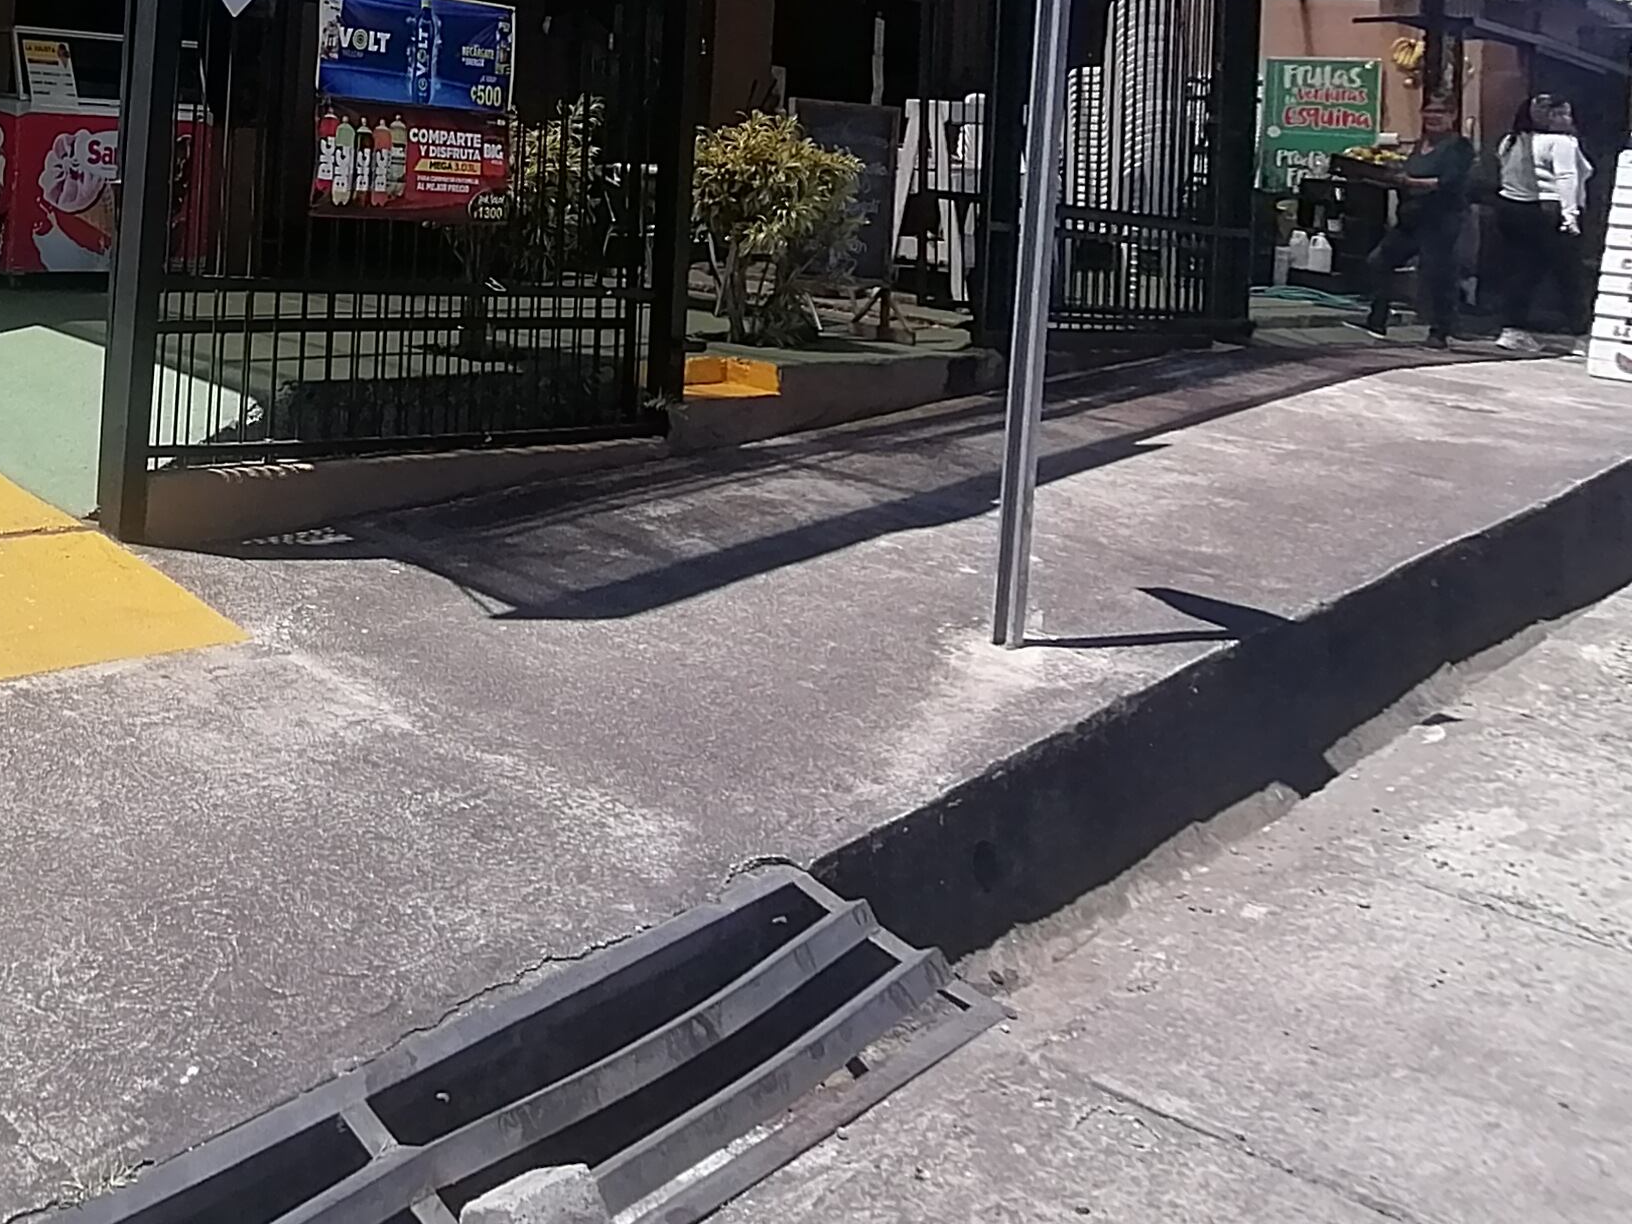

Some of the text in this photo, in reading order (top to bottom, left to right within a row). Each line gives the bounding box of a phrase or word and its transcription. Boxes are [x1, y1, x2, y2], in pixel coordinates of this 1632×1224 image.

[338, 25, 392, 54] VOLT
[1282, 64, 1363, 89] Frutas
[1281, 104, 1373, 131] Esquina
[409, 127, 482, 149] COMPARTE
[419, 145, 481, 161] Y DISFRUTA
